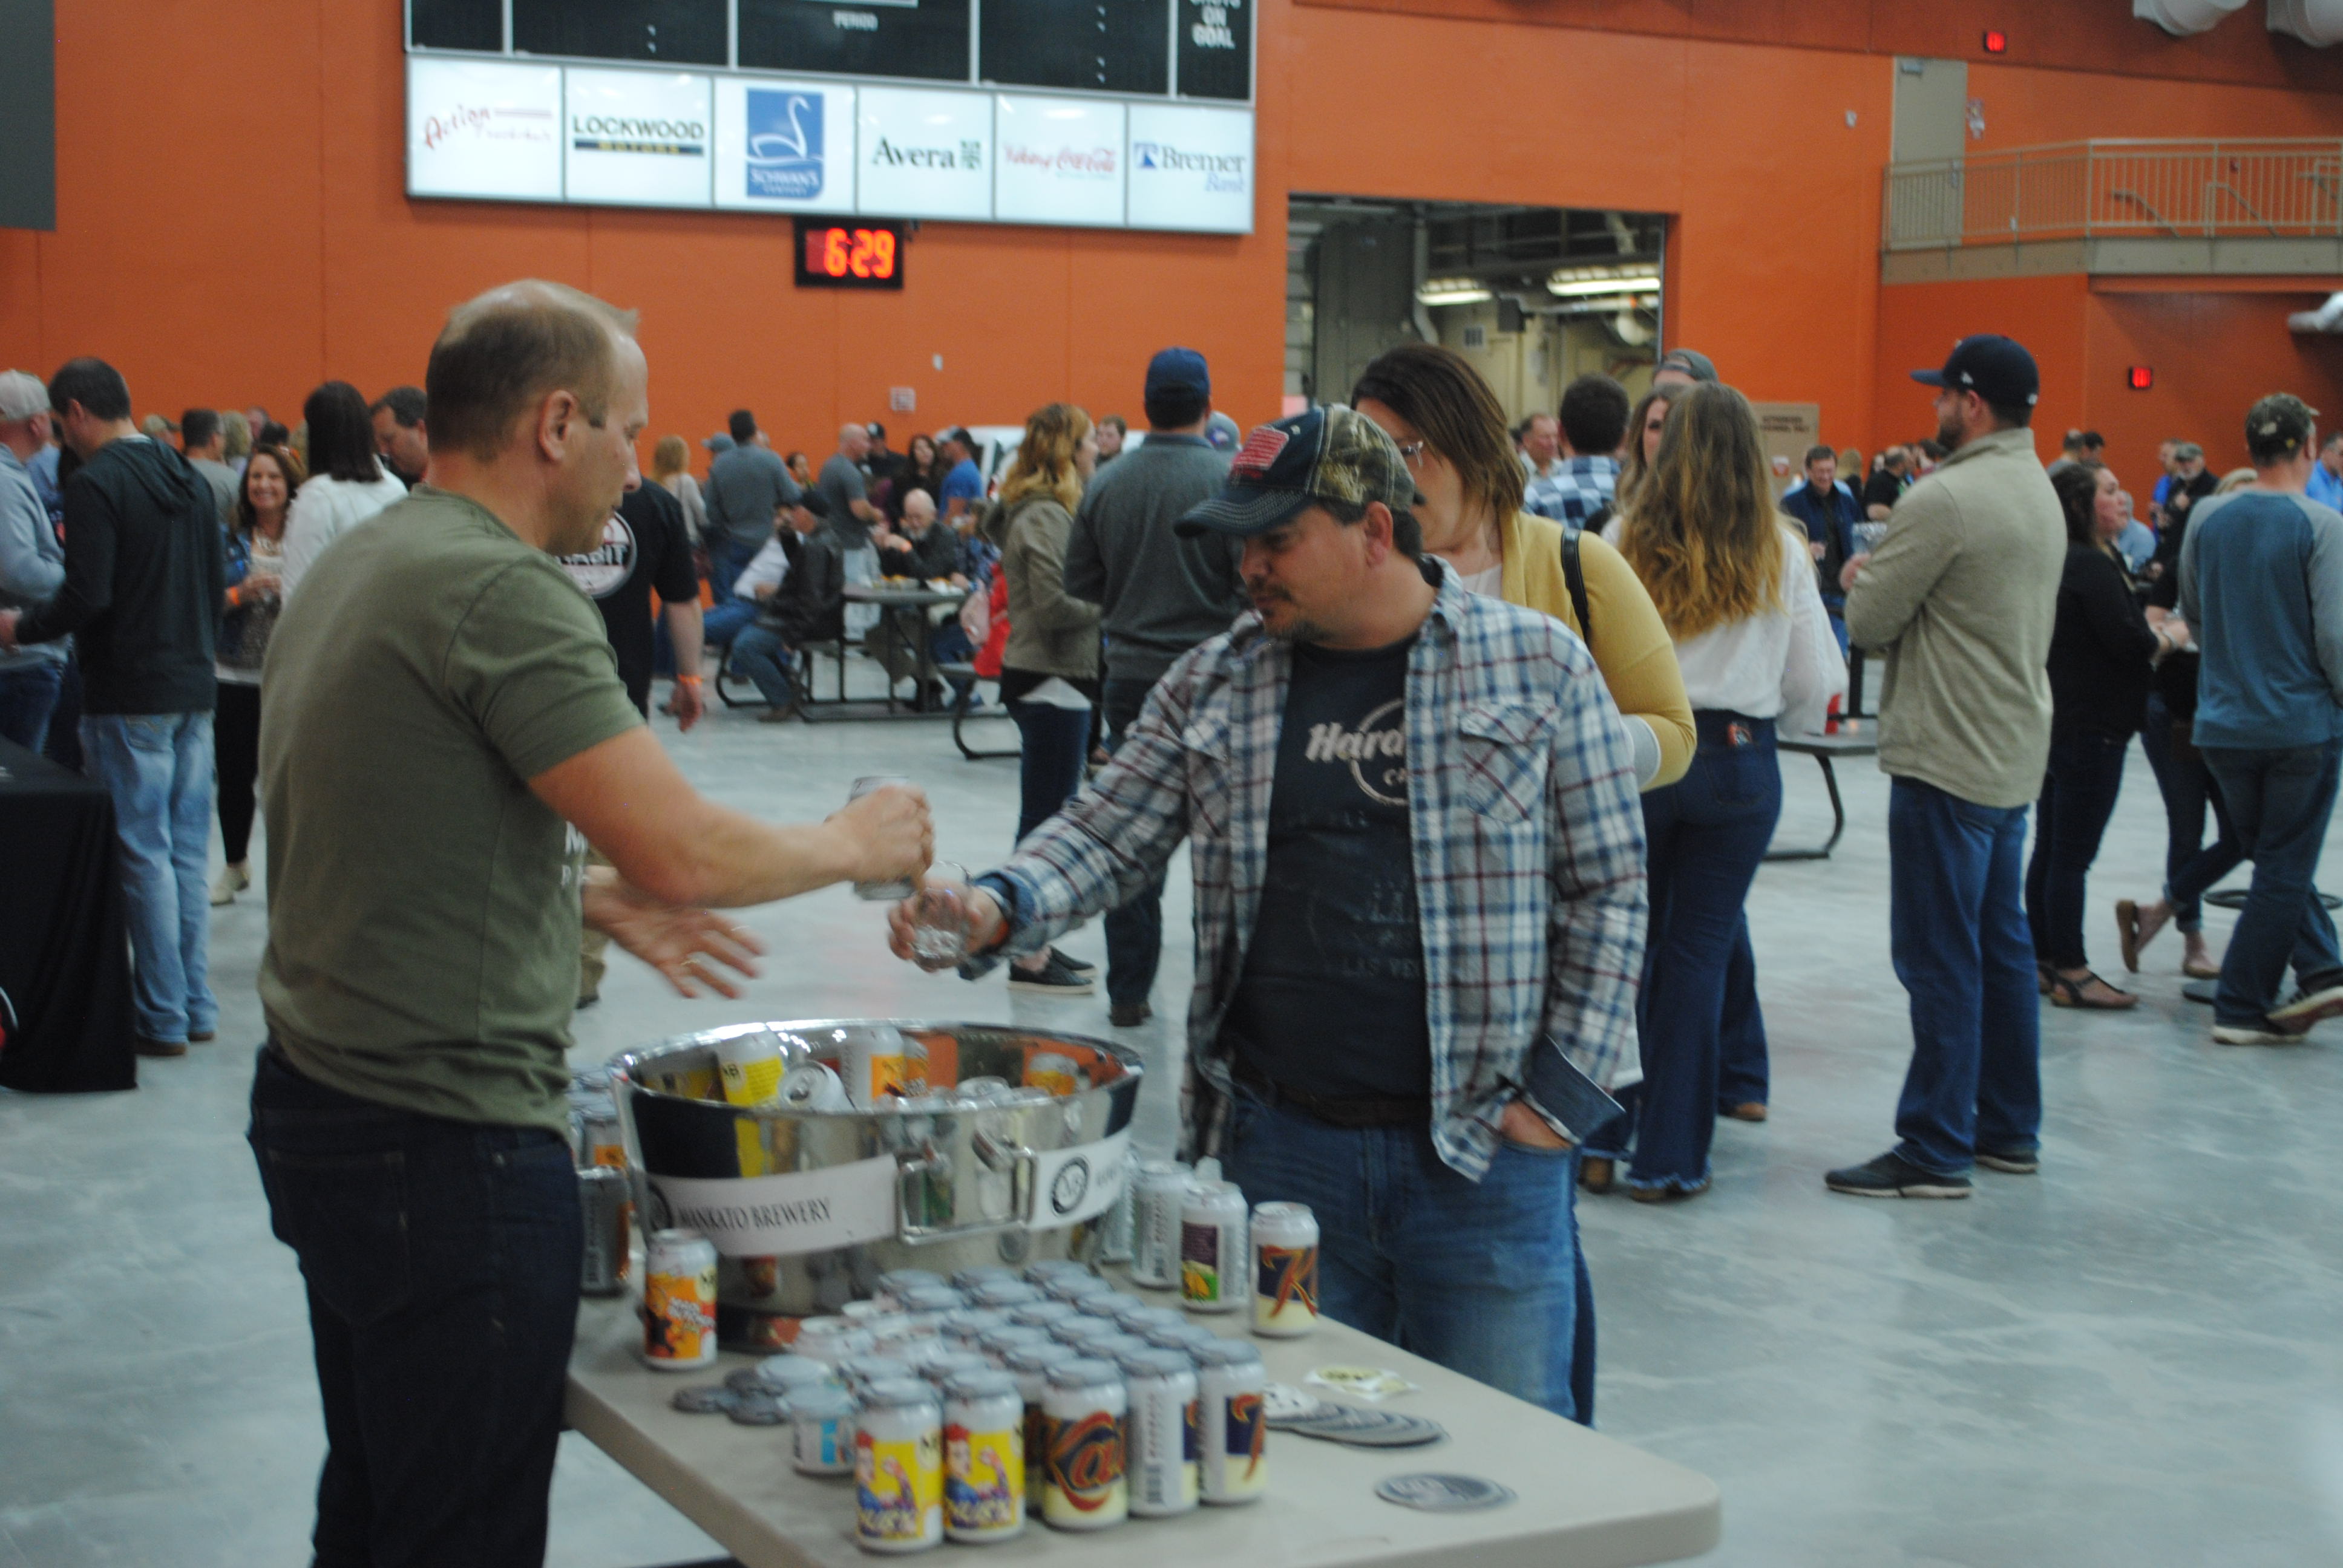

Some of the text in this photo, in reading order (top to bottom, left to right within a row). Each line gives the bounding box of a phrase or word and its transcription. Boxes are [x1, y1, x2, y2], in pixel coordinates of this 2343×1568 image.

[573, 114, 704, 140] LOCKWOOD
[872, 137, 955, 169] Avera
[1161, 145, 1247, 173] Bremer
[750, 1197, 831, 1229] BREWERY
